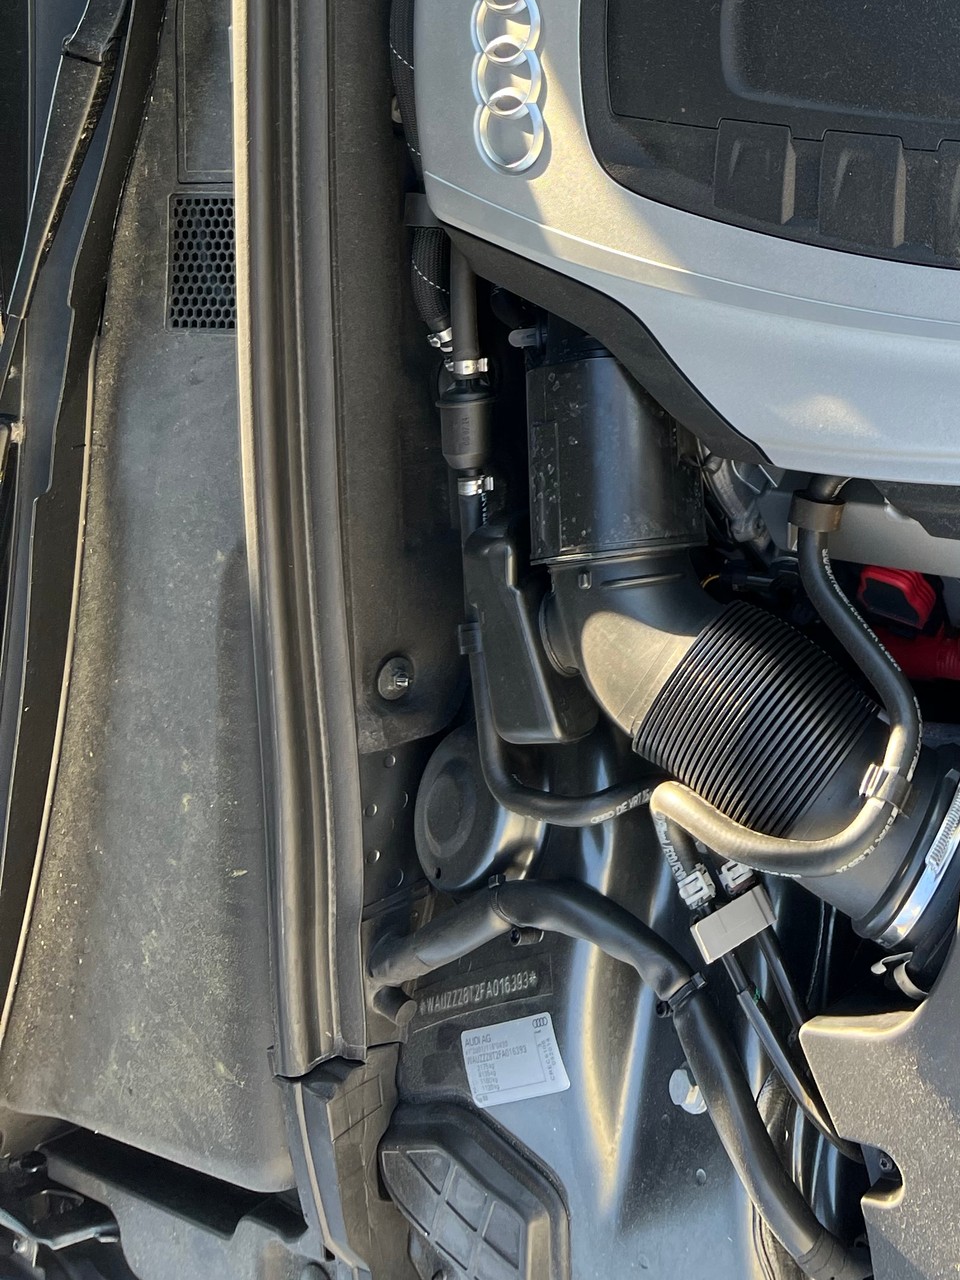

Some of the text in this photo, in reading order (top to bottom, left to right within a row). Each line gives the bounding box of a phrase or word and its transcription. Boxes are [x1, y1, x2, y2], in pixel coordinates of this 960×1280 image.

[616, 800, 628, 815] DE
[465, 1033, 492, 1047] AUDI AG
